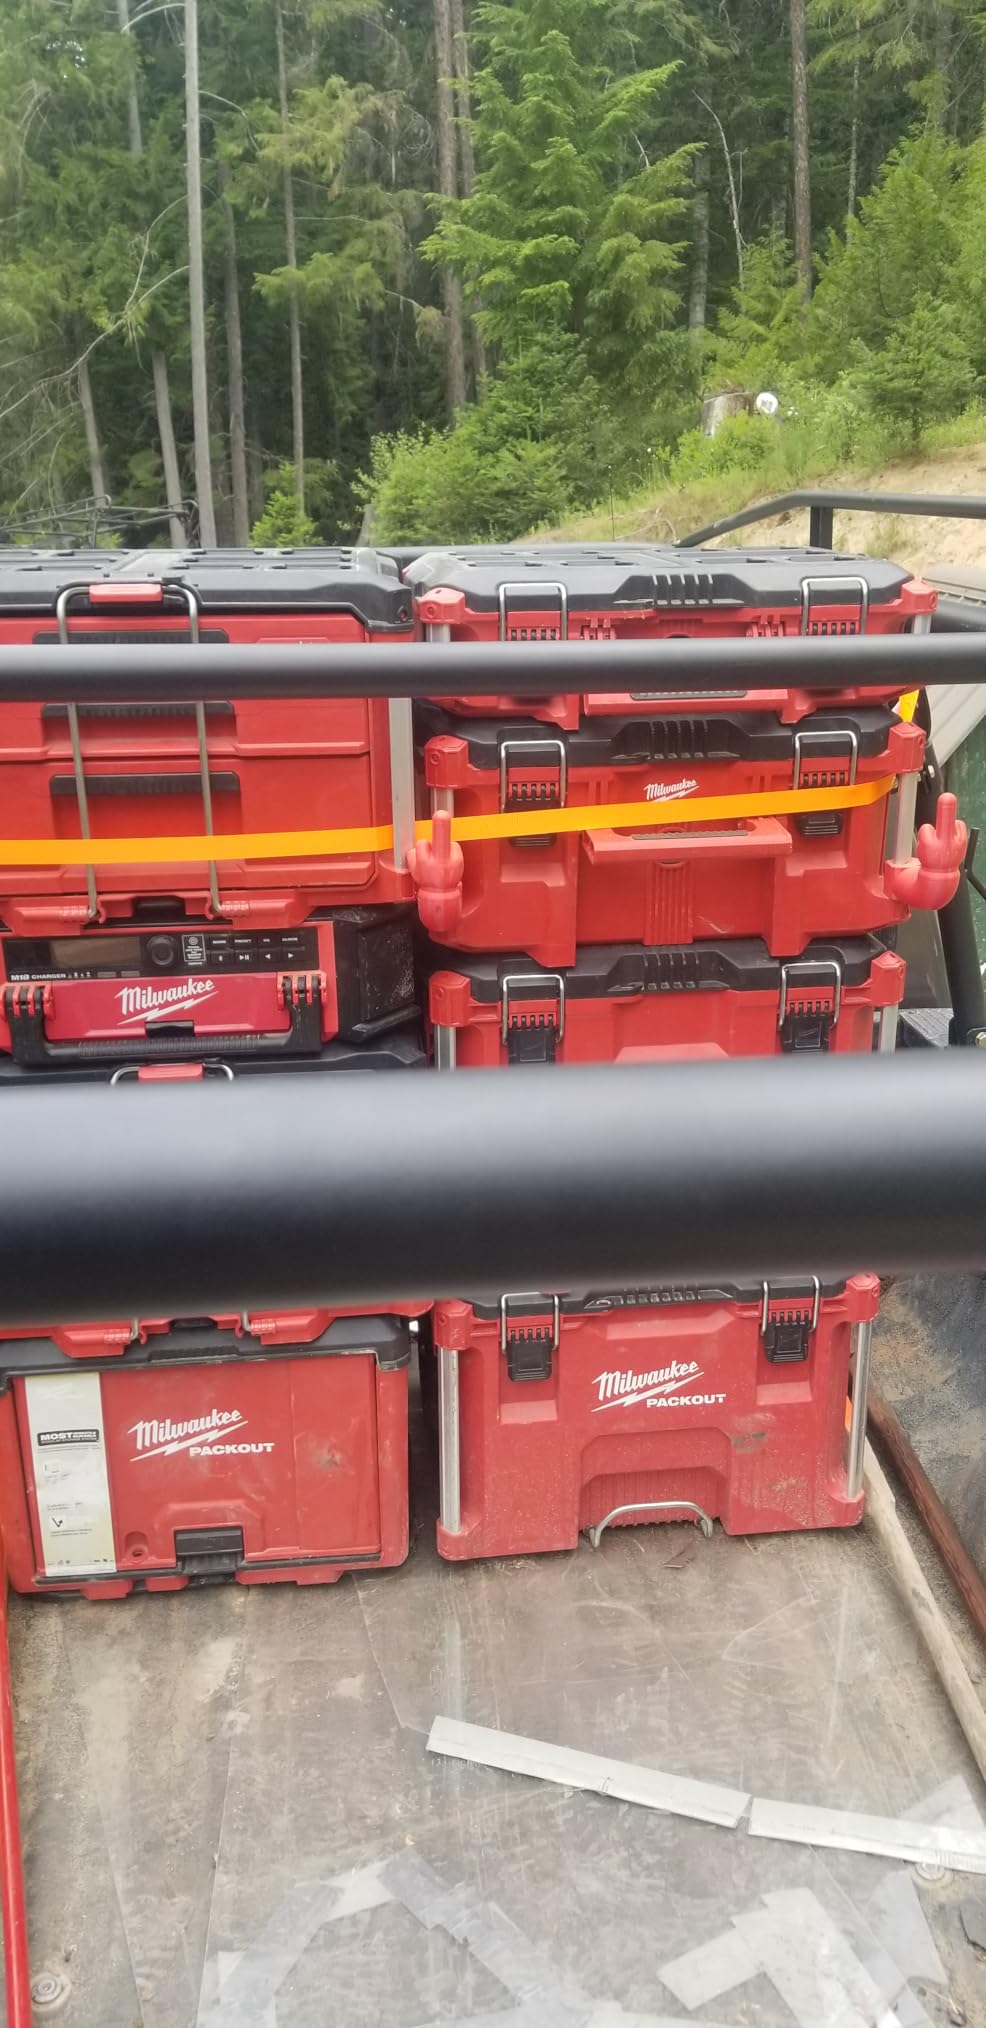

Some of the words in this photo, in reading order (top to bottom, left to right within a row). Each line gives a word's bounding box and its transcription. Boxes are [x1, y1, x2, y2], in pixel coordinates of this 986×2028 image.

[643, 778, 697, 800] Milwaukee
[116, 978, 215, 1015] Milwaukee
[592, 1360, 700, 1400] Milwaukee
[646, 1394, 726, 1408] PACKOUT
[40, 1432, 73, 1440] MOST
[128, 1409, 242, 1450] Milwaukee
[189, 1442, 275, 1457] PACKOUT
